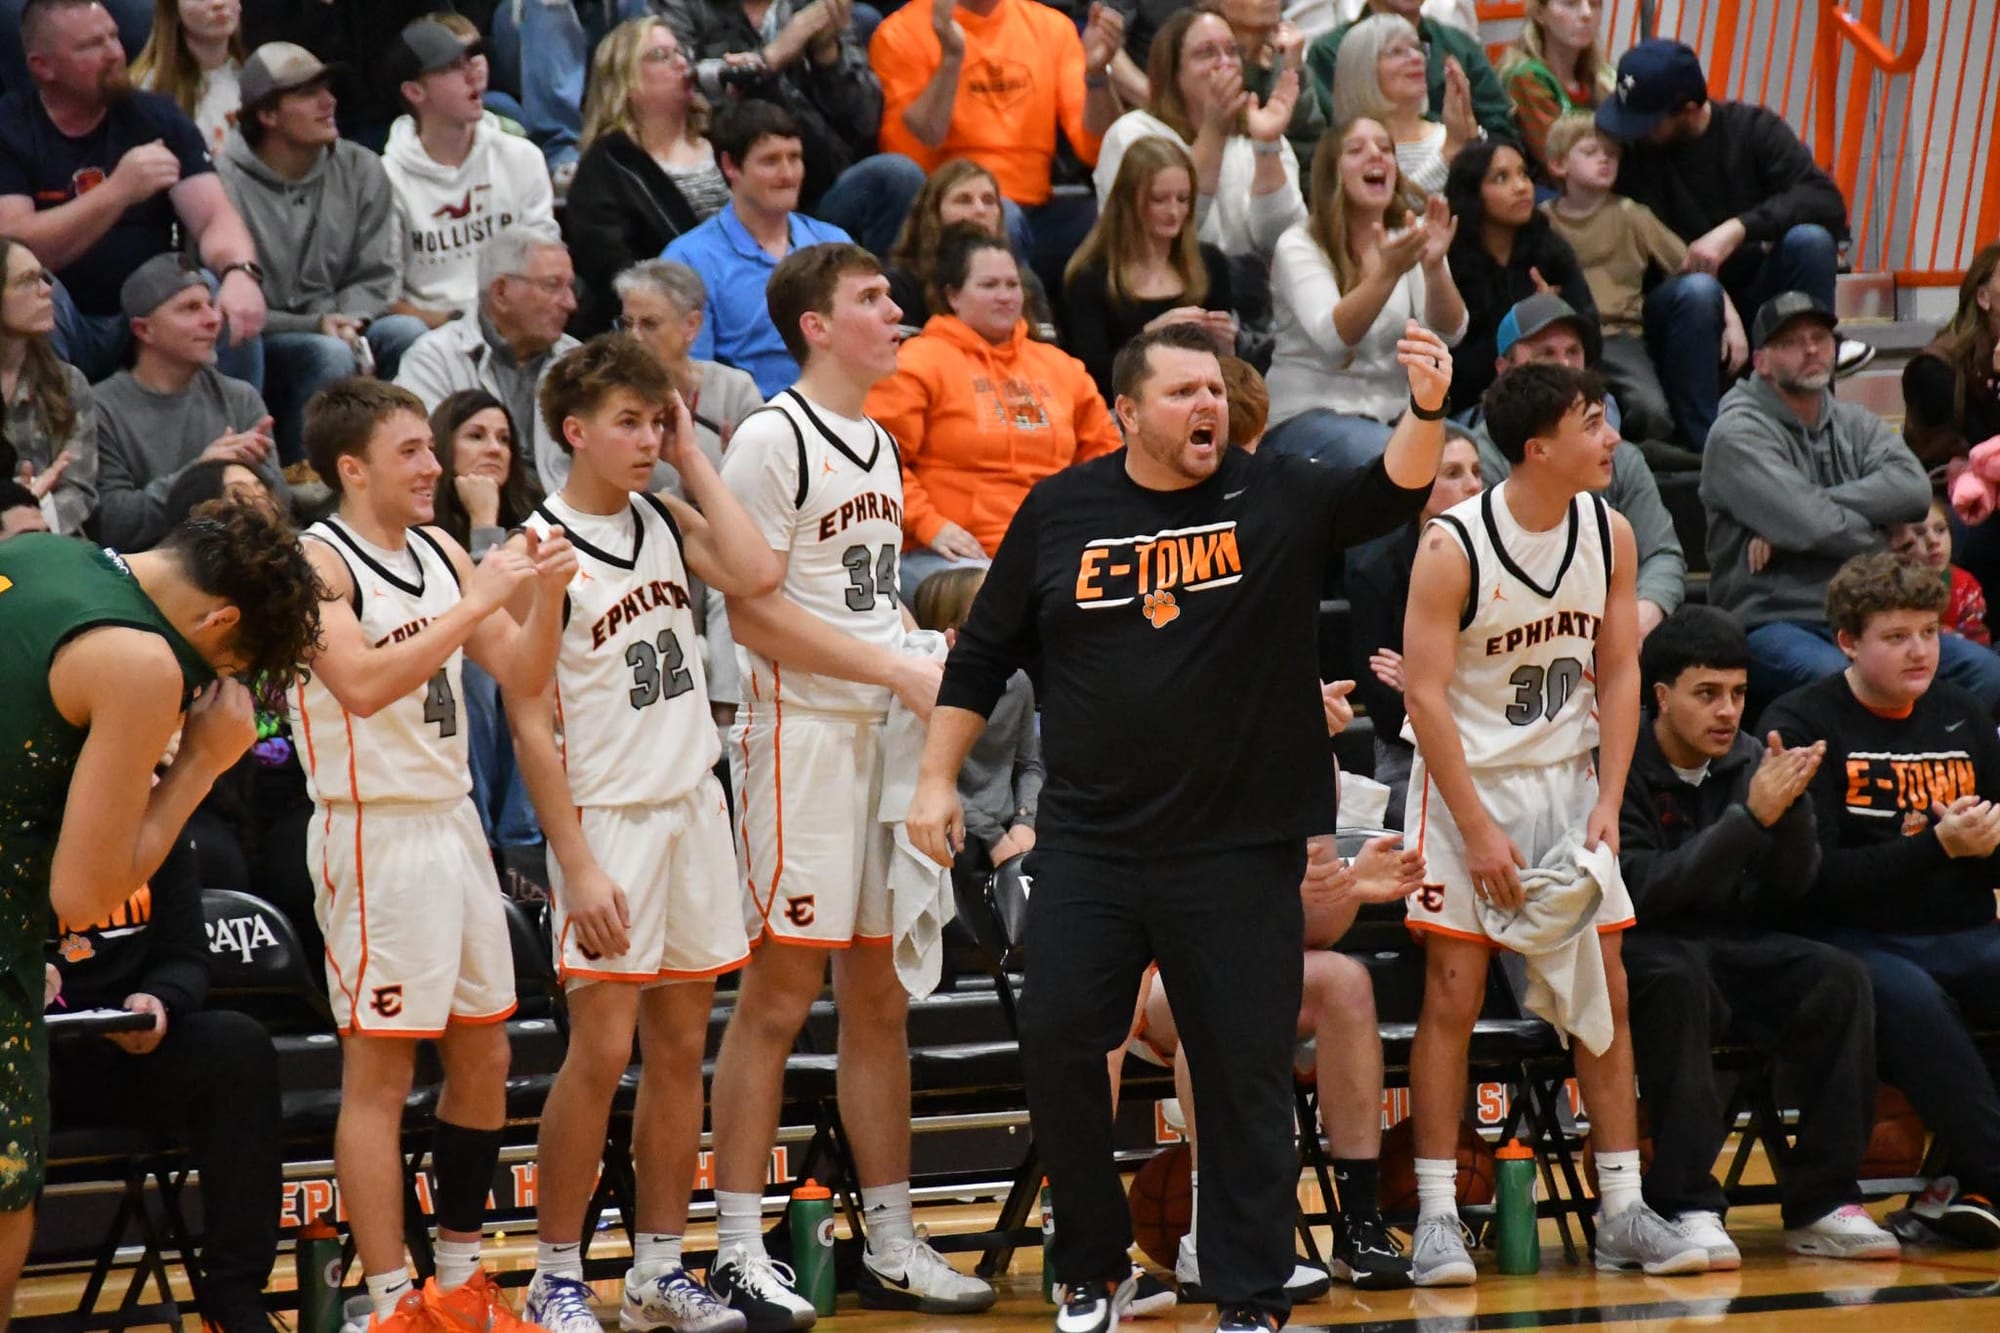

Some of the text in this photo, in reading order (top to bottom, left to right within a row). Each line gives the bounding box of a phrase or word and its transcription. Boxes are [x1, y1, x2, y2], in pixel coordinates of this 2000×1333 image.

[411, 212, 512, 252] HOLLISTR
[842, 544, 898, 611] 34
[1075, 528, 1242, 600] E-TOWN
[423, 667, 456, 738] 4
[624, 628, 694, 711] 32
[1505, 657, 1582, 726] 30
[1845, 759, 1976, 810] E-TOWN
